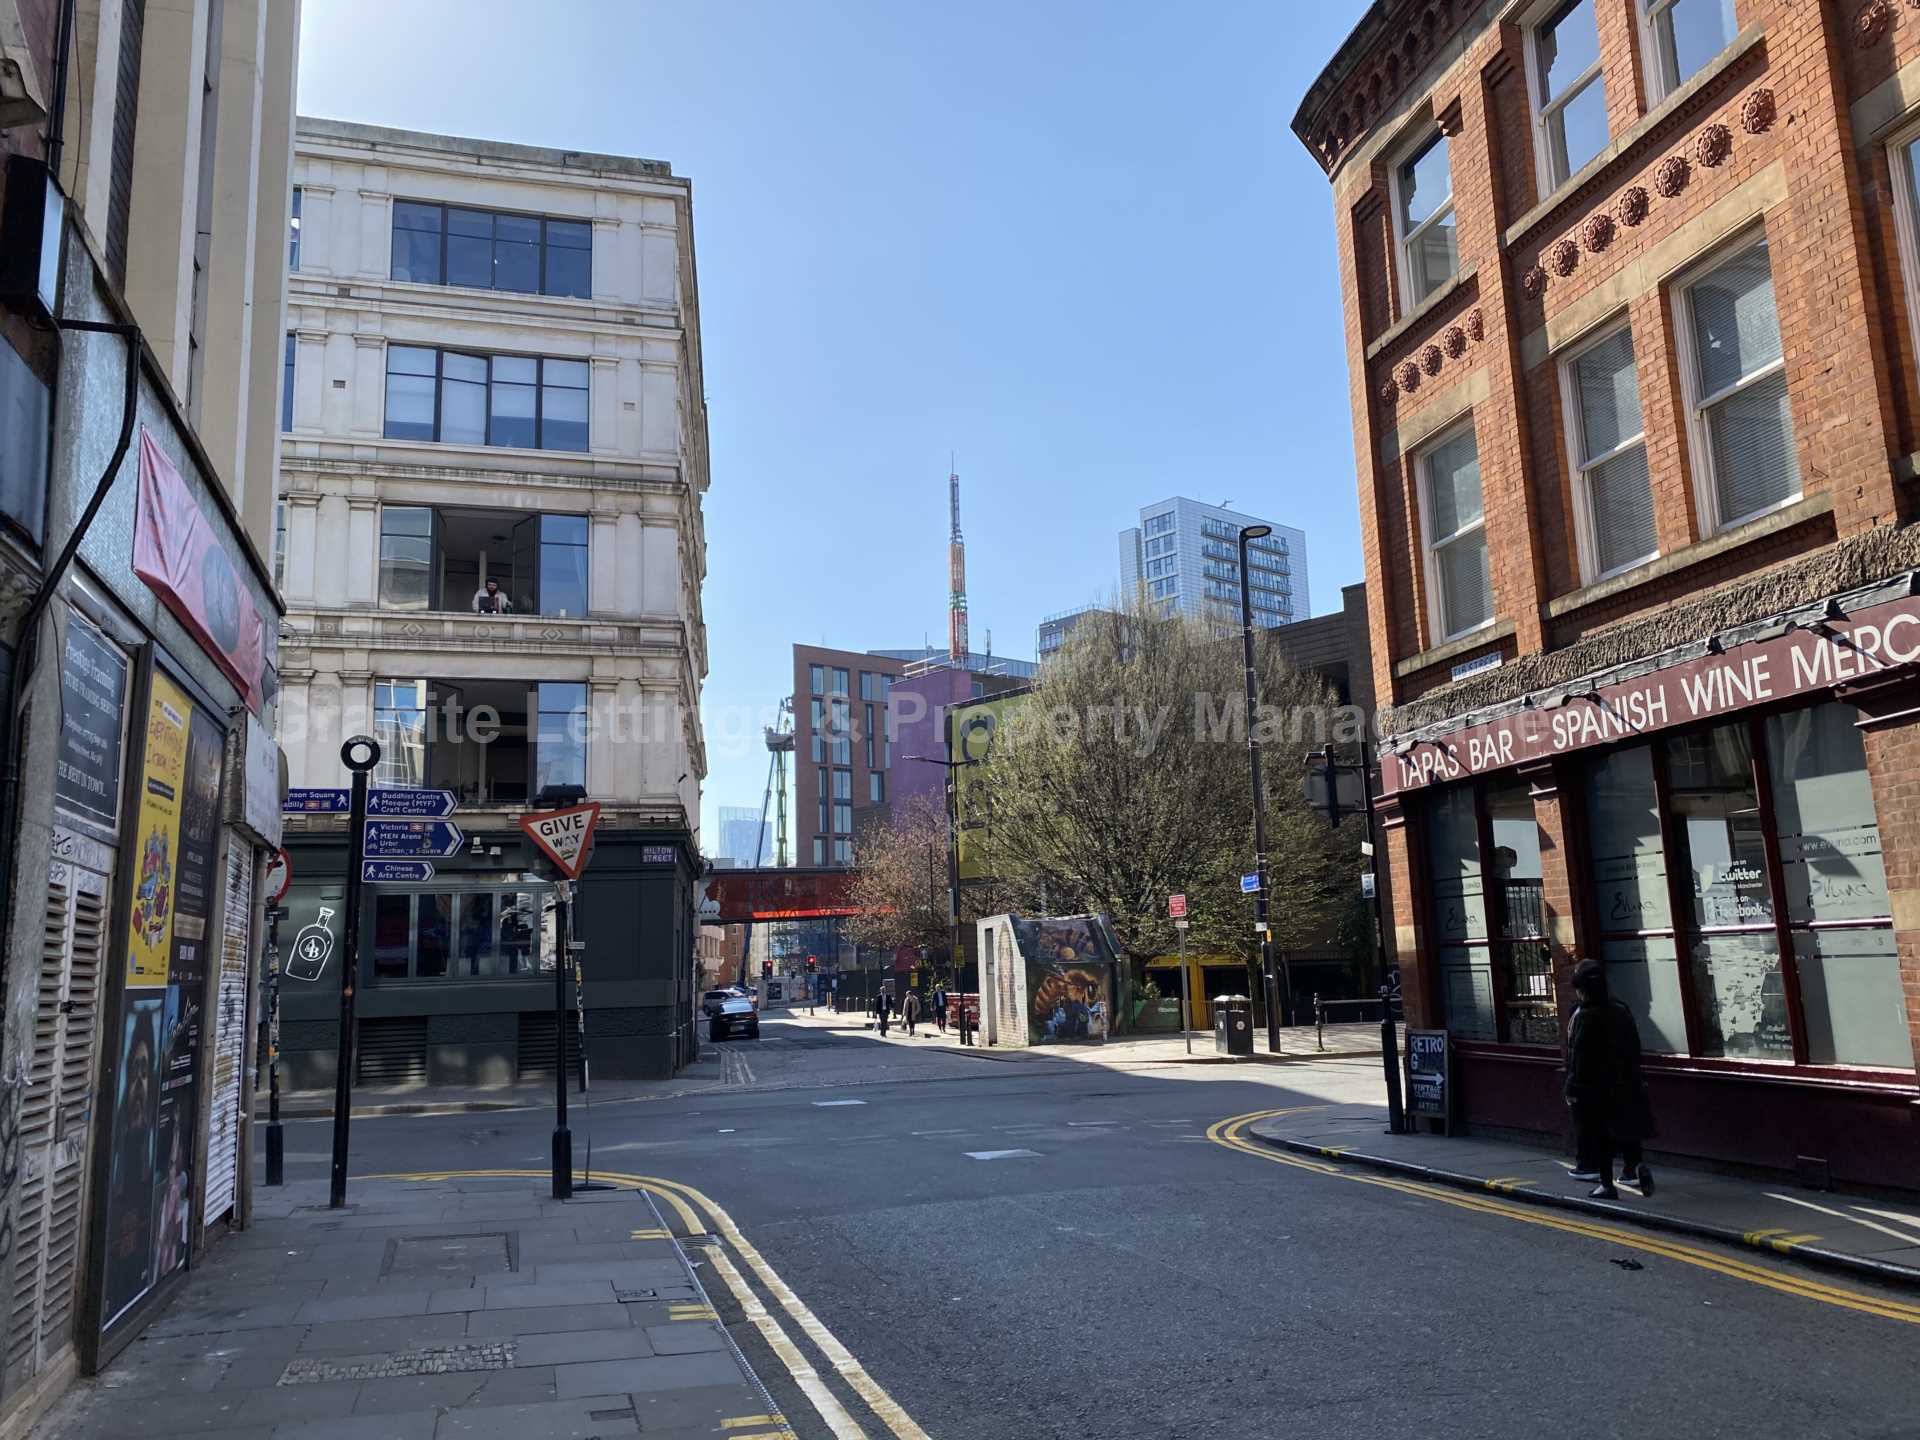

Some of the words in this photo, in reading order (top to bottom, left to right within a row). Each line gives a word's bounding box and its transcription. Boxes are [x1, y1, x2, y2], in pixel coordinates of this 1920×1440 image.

[1398, 744, 1460, 788] TAPAS
[1469, 729, 1514, 772] BAR
[1552, 684, 1669, 750] SPANISH
[1680, 654, 1773, 716] WINE
[1790, 613, 1920, 689] MERC
[309, 791, 336, 800] Square
[381, 799, 410, 807] Mosque
[381, 806, 400, 814] Craft
[402, 806, 427, 814] Centre
[380, 823, 408, 831] Victoria
[540, 814, 585, 837] GIVE
[552, 834, 580, 848] WAY
[643, 846, 672, 854] HILTON
[643, 854, 673, 862] STREET
[384, 864, 414, 872] Chinese
[1719, 867, 1762, 882] twitter
[1410, 1035, 1444, 1053] RETRO
